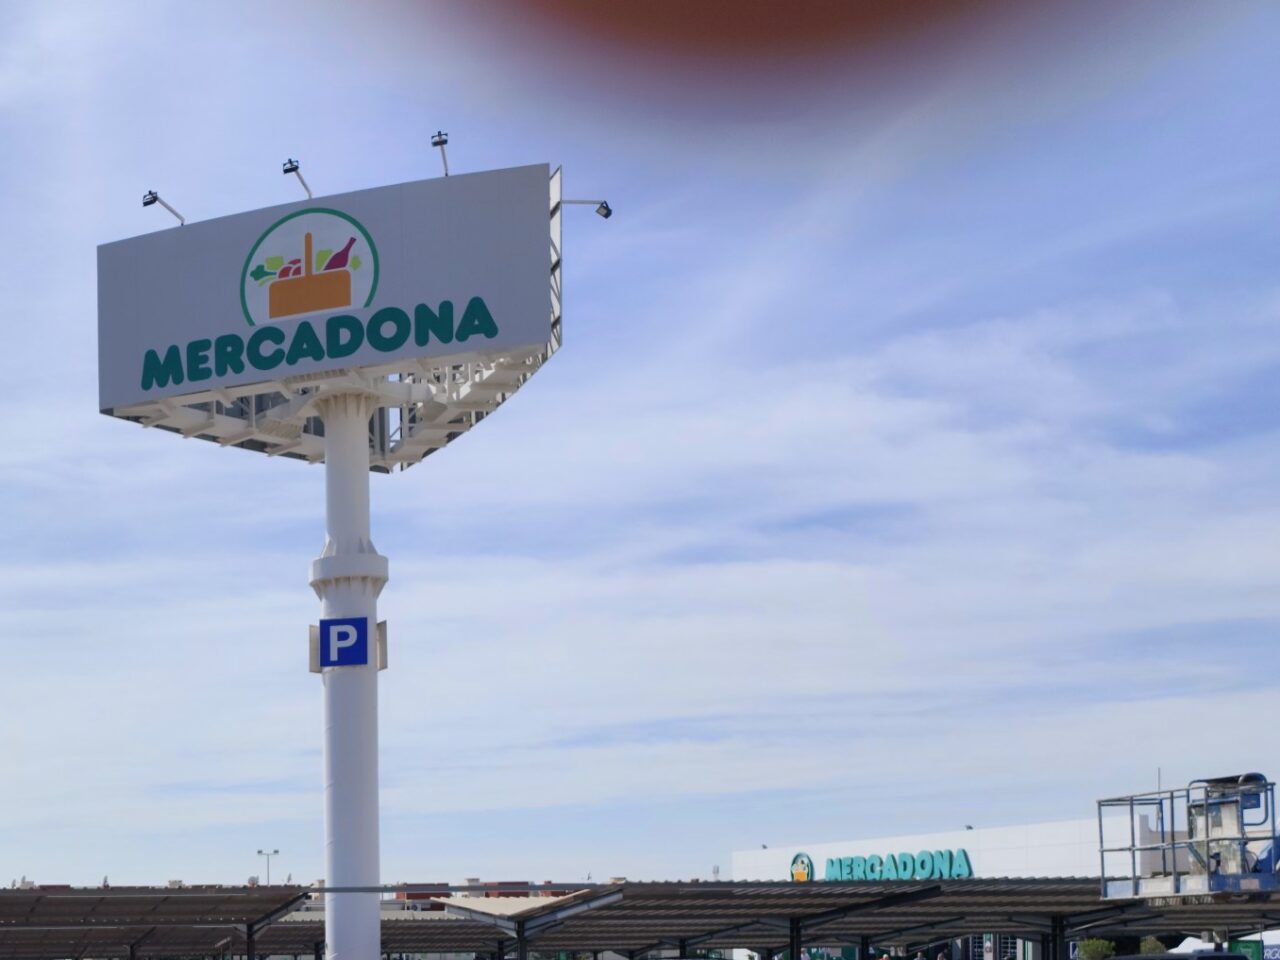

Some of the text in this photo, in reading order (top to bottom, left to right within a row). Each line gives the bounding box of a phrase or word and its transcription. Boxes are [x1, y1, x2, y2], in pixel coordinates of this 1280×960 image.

[141, 296, 499, 391] MERCADONA
[329, 624, 358, 662] P
[825, 848, 975, 881] MERCADONA
